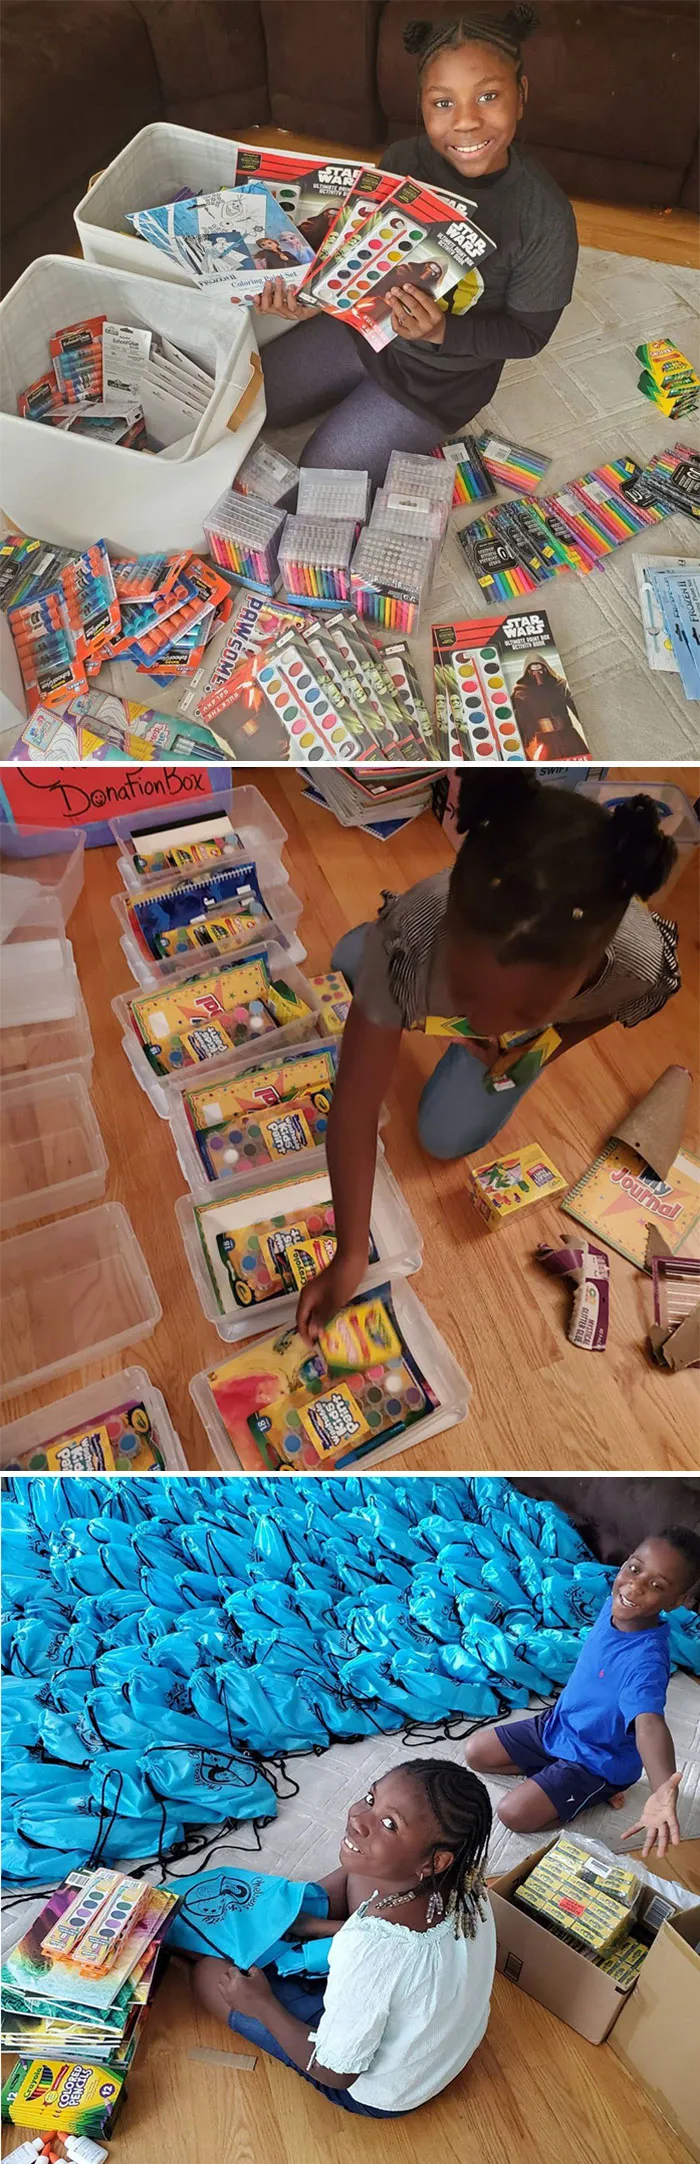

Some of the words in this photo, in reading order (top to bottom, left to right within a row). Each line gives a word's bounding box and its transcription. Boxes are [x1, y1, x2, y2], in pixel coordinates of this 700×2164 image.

[318, 170, 355, 186] WAR
[445, 225, 479, 258] WARS
[449, 222, 487, 257] STAR
[231, 277, 264, 289] Coloring
[502, 623, 545, 638] WARS
[505, 615, 544, 630] STAR
[205, 594, 264, 692] PAWSOME
[267, 1121, 287, 1155] Paint
[610, 1167, 683, 1220] Journal
[256, 1419, 267, 1432] 18
[314, 1401, 342, 1447] Washable
[331, 1393, 360, 1434] Paint
[7, 2091, 18, 2102] 12
[23, 2066, 43, 2098] Crayola
[59, 2065, 82, 2108] COLORED
[69, 2069, 92, 2106] PENCILS
[101, 2084, 114, 2097] 12
